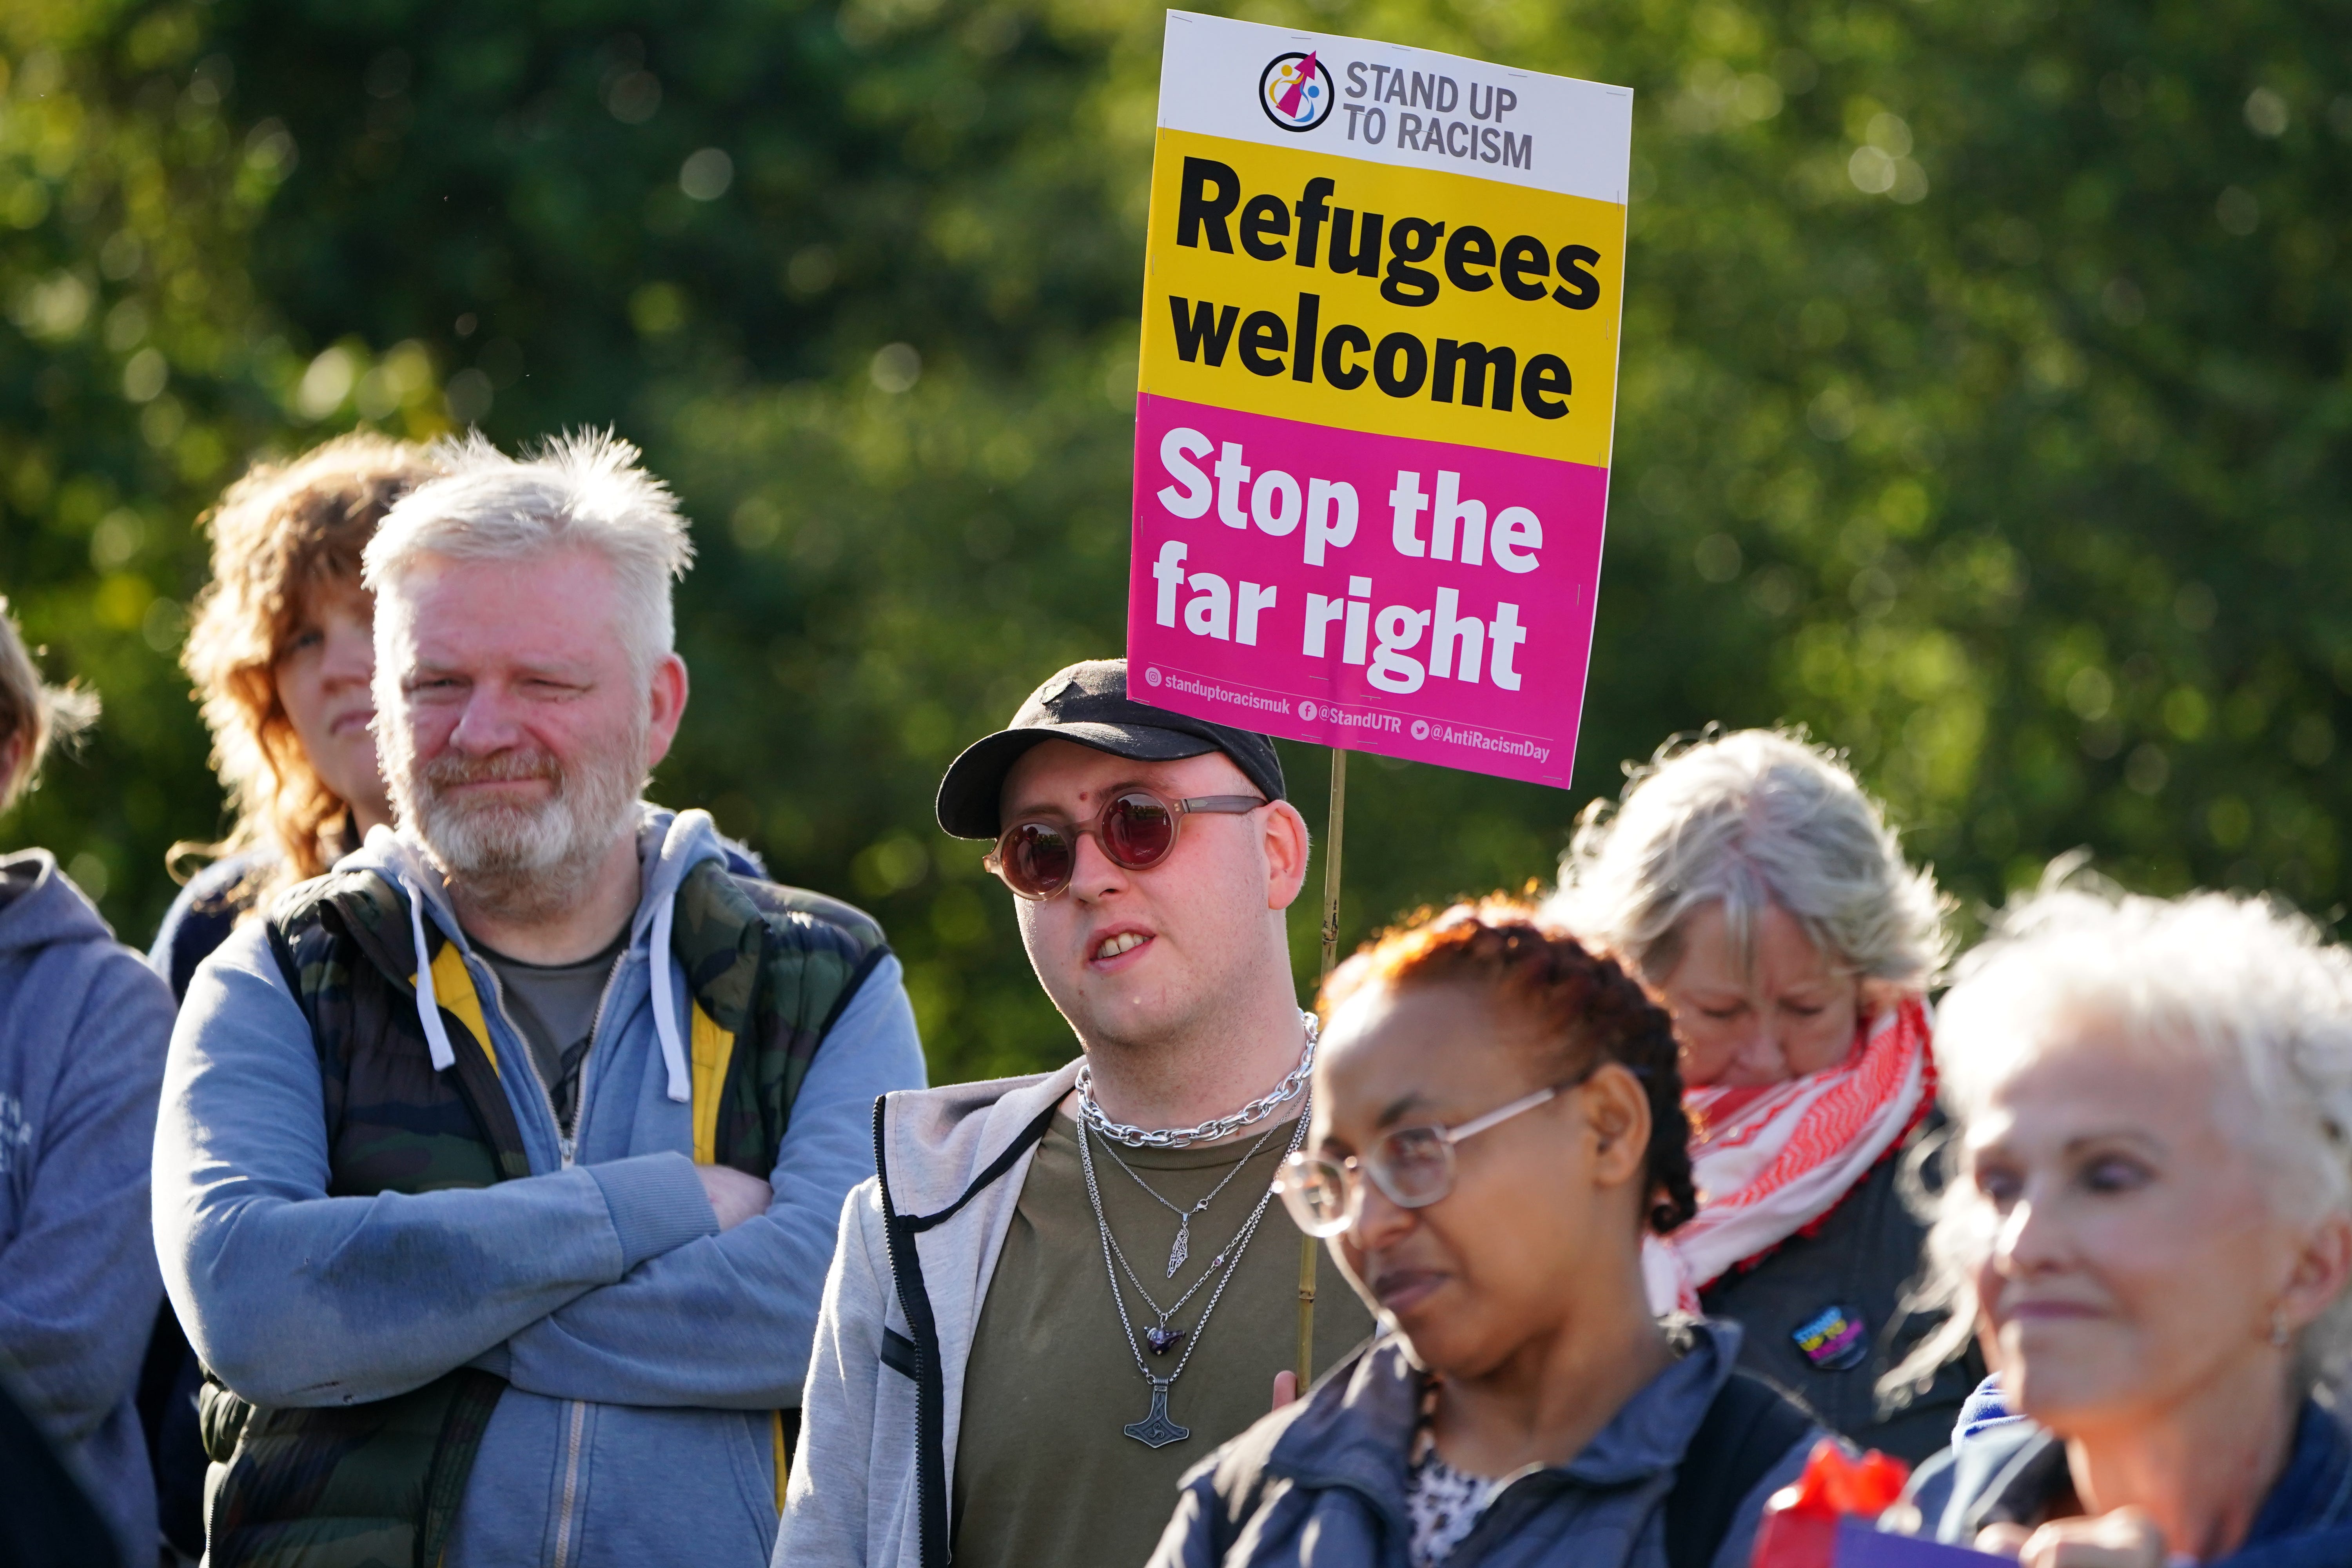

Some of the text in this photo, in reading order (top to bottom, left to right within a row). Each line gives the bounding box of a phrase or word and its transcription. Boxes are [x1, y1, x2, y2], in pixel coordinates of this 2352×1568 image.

[1343, 103, 1532, 170] TO RACISM
[1345, 61, 1517, 123] STAND UP
[1176, 156, 1601, 310] Refugees
[1169, 292, 1572, 419] welcome
[1157, 427, 1543, 573] Stop the
[1153, 540, 1527, 694] far right
[1165, 675, 1290, 715] standuptoracismuk
[1319, 705, 1402, 733] @StandUTR
[1430, 724, 1550, 764] @AntiRacismDay
